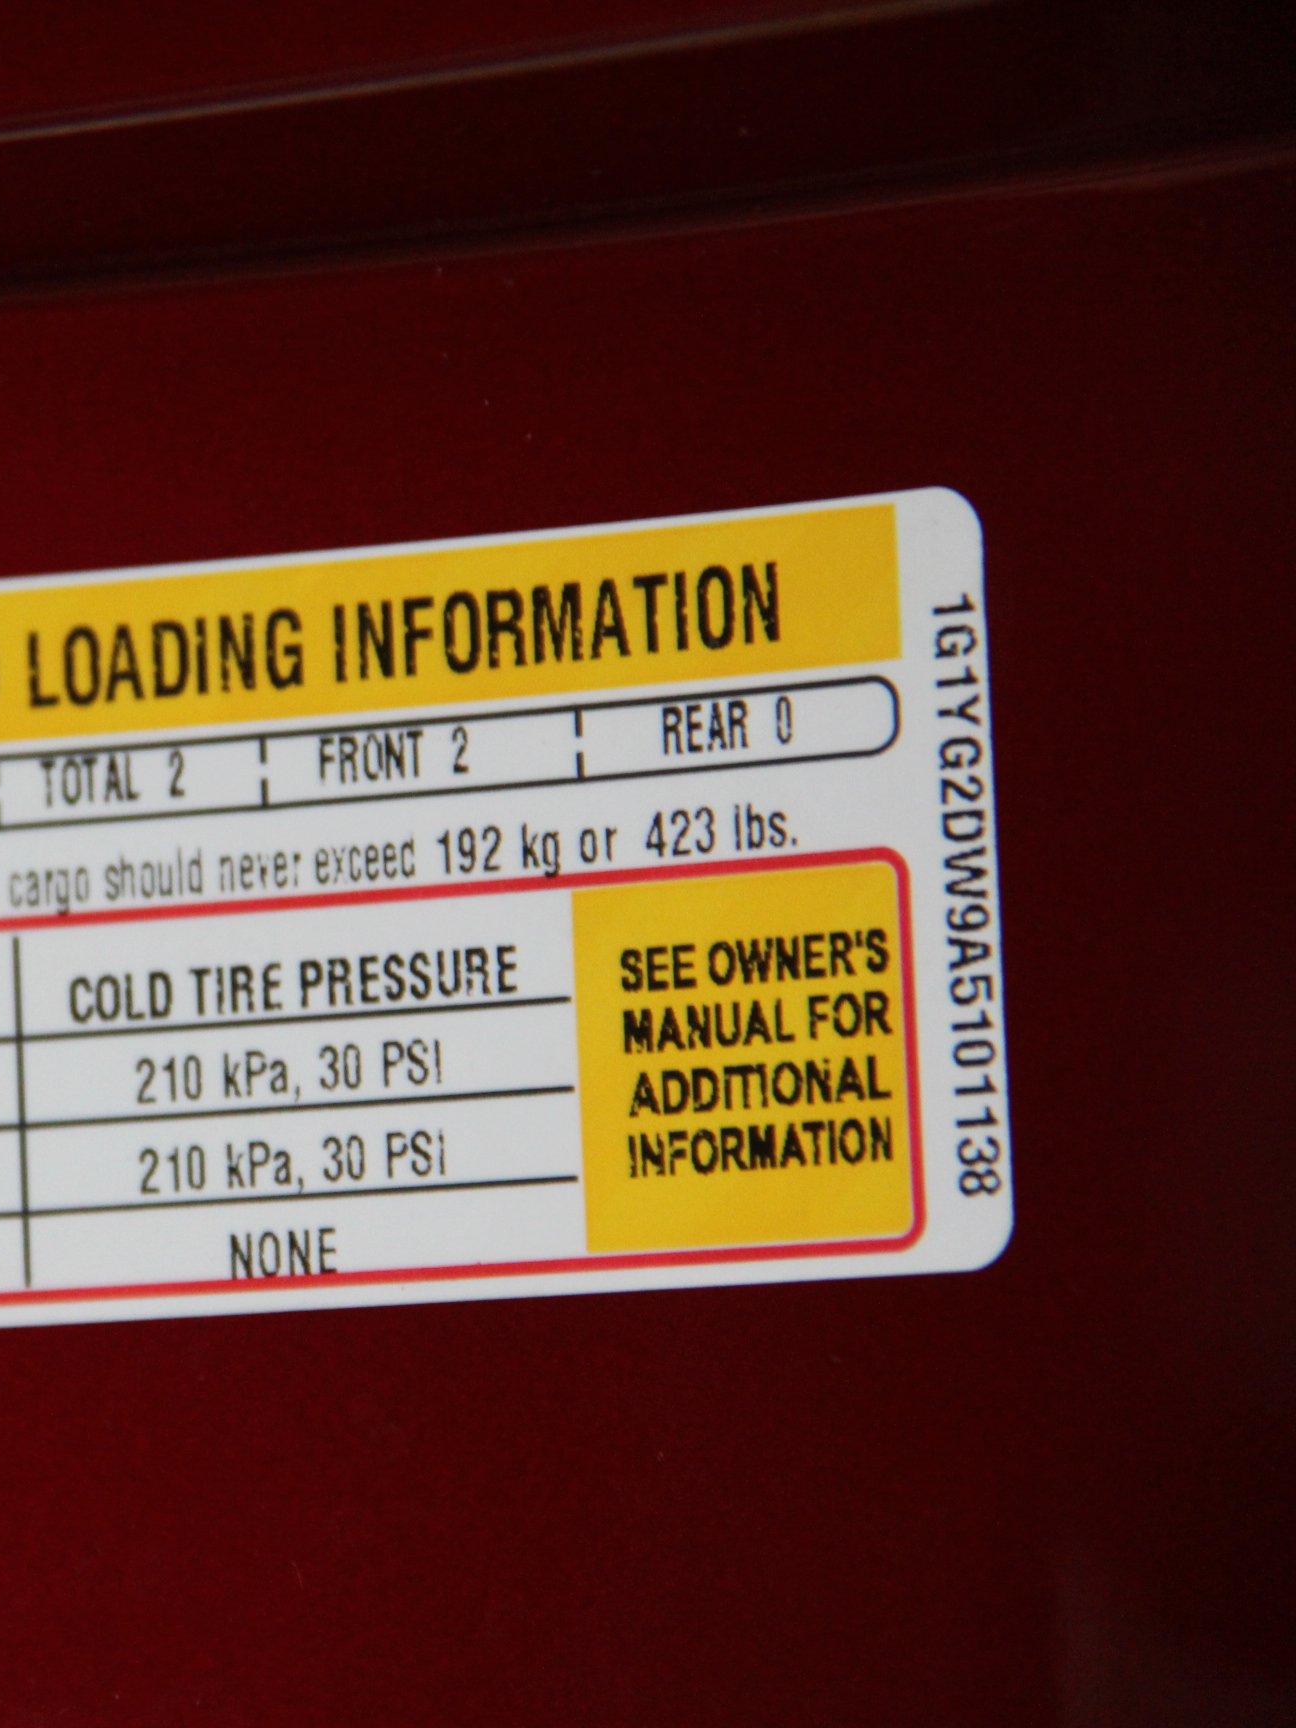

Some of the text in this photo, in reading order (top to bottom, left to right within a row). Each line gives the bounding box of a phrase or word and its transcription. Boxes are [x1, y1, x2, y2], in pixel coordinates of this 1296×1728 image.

[27, 608, 304, 709] LOADING
[333, 561, 780, 682] INFORMATION
[319, 726, 469, 785] FRONT 2
[662, 696, 792, 755] REAR 0
[40, 750, 185, 808] TOTAL 2
[9, 866, 90, 915] cargo
[106, 845, 203, 899] should
[220, 850, 301, 892] never
[315, 834, 415, 884] exceed
[438, 825, 502, 875] 192
[522, 823, 559, 877] kg
[580, 827, 617, 863] or
[646, 806, 715, 858] 423
[734, 802, 797, 850] lbs.
[931, 592, 1003, 1198] 1G1YG2DW9A5101138
[69, 944, 518, 1023] COLD TIRE PRESSURE
[620, 928, 890, 992] SEE OWNER'S
[623, 990, 892, 1054] MANUAL FOR
[135, 1038, 442, 1104] 210 kPa, 30 PSI
[628, 1055, 892, 1117] ADDITIONAL
[139, 1128, 446, 1194] 210 kPa, 30 PSI
[628, 1116, 893, 1178] INFORMATION
[230, 1227, 338, 1280] NONE
